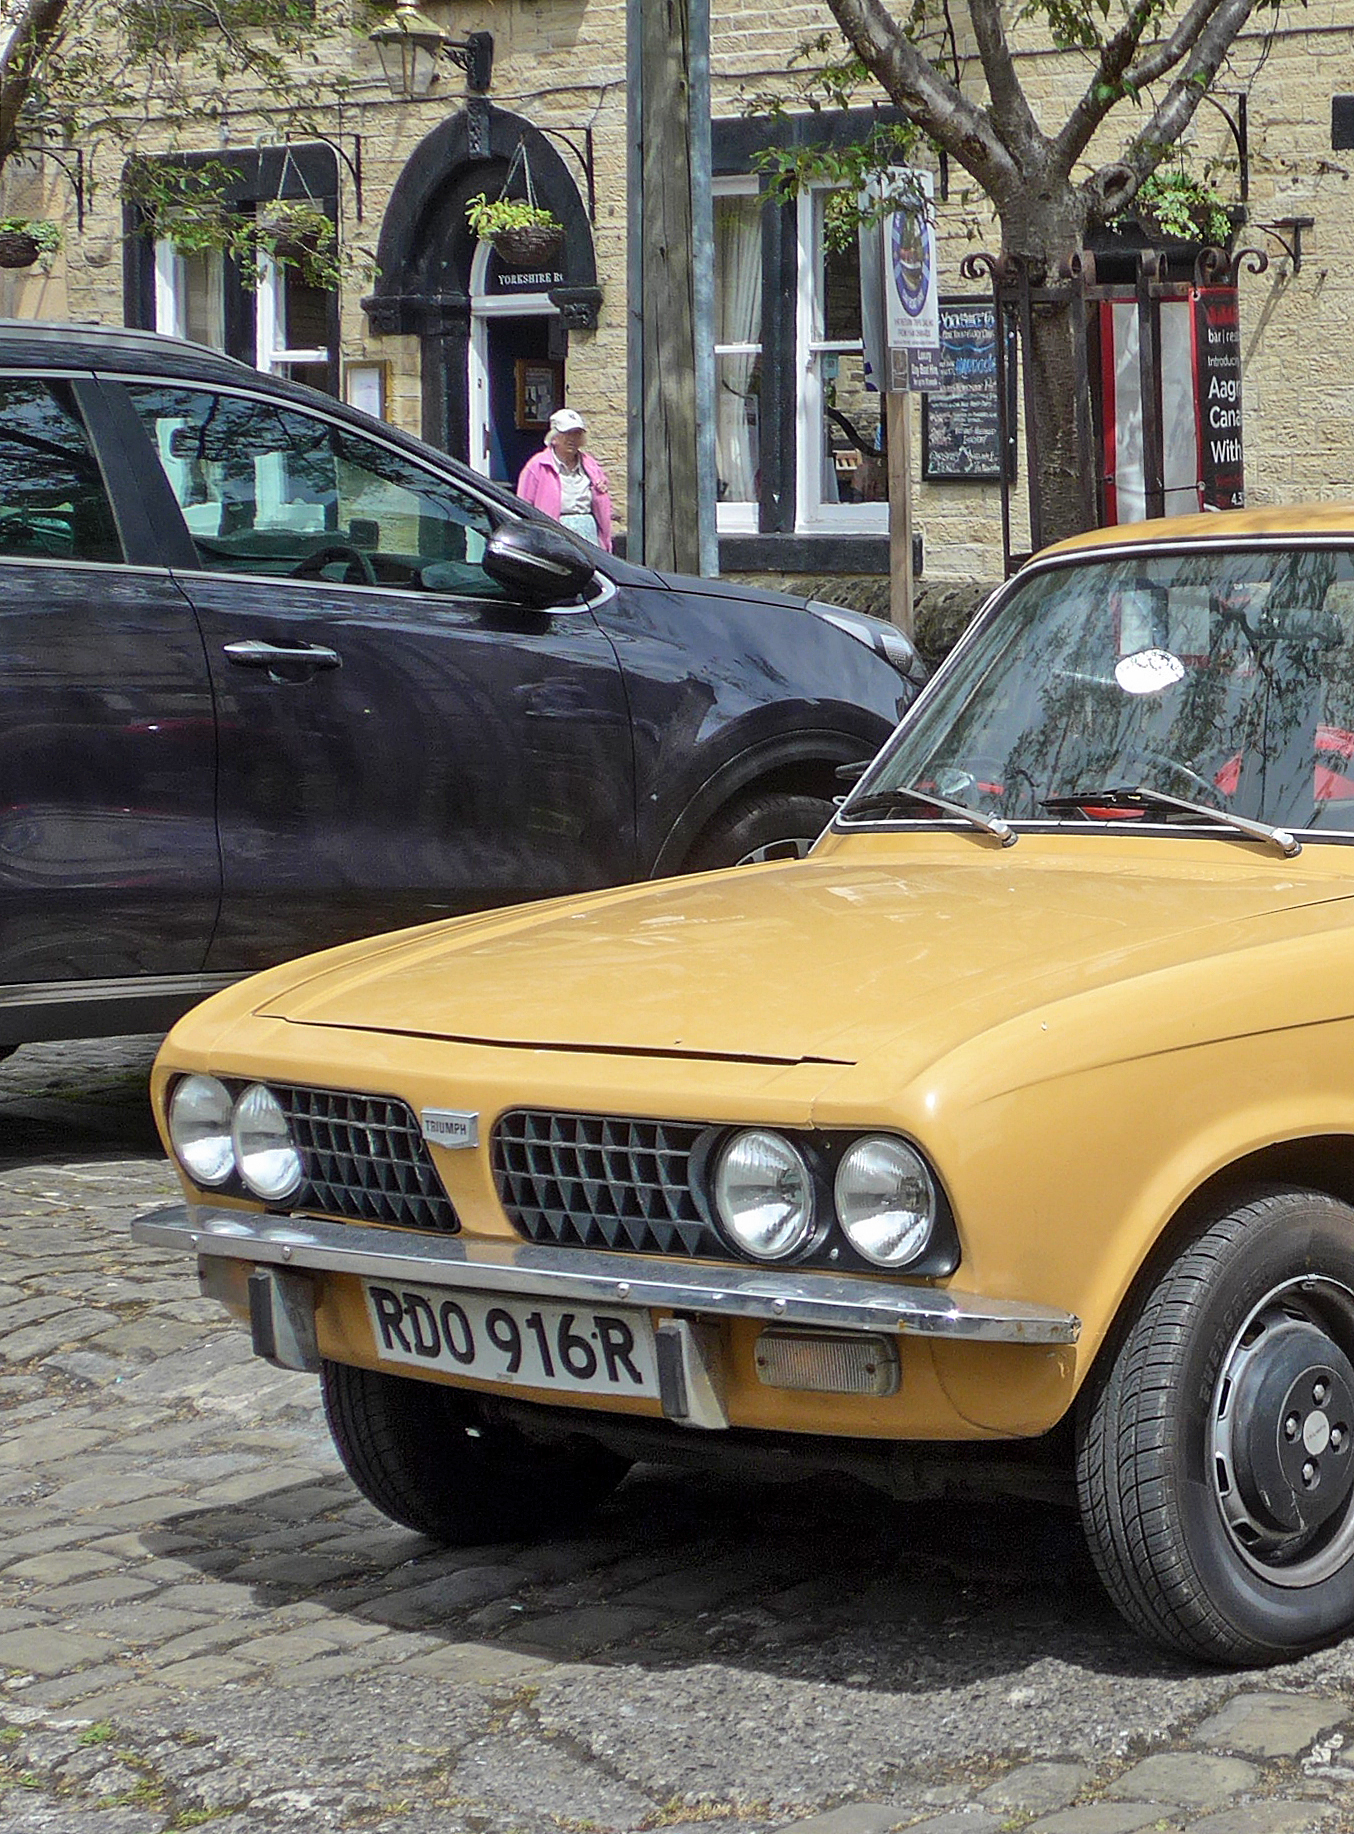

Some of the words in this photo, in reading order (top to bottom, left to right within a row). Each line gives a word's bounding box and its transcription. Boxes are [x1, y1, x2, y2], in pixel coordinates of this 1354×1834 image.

[498, 272, 552, 286] YORKSHIRE
[425, 1119, 467, 1135] TRIUMPH
[369, 1286, 475, 1365] RDO
[485, 1307, 644, 1385] 916R
